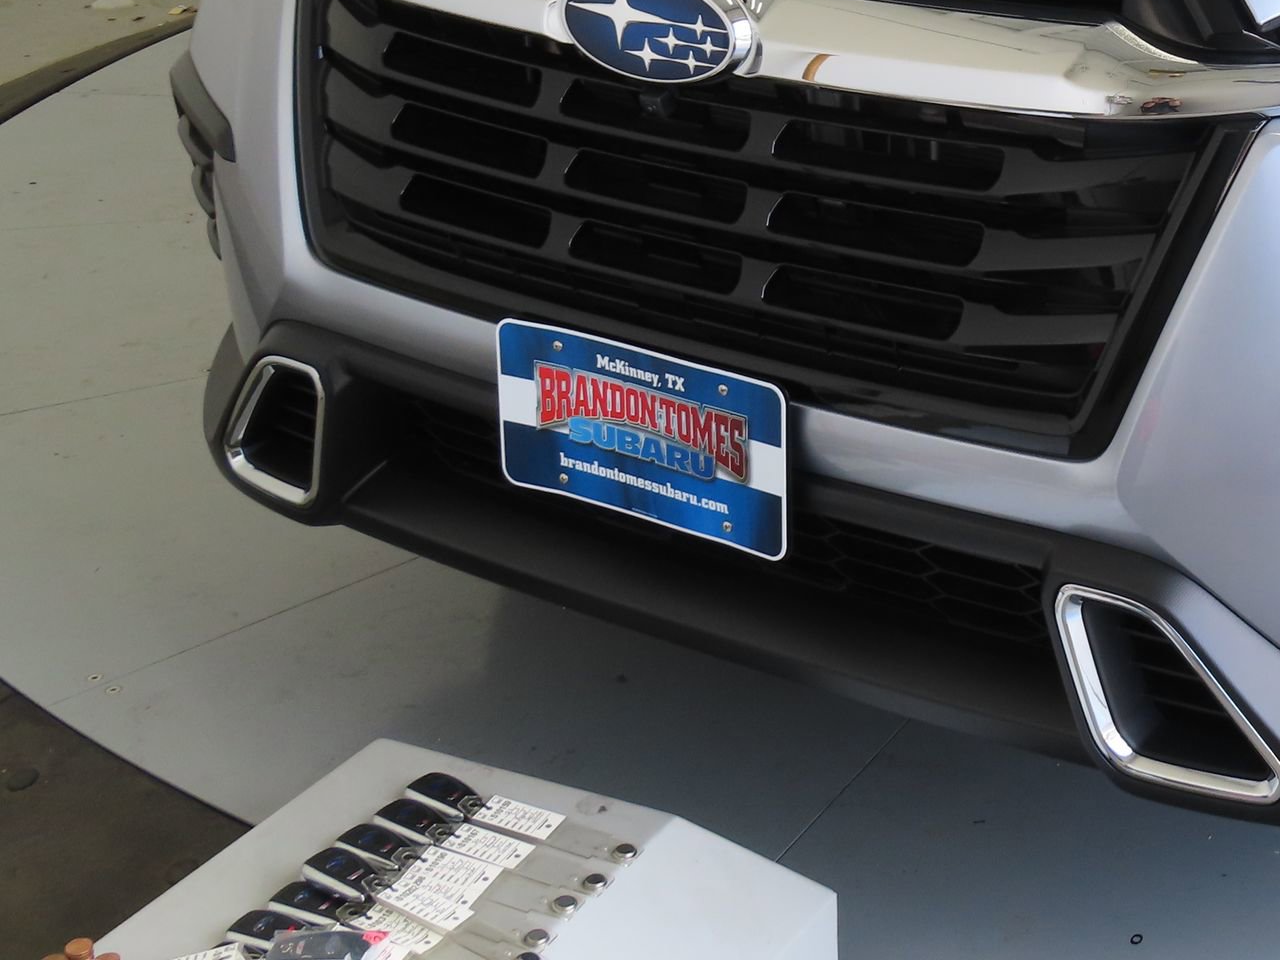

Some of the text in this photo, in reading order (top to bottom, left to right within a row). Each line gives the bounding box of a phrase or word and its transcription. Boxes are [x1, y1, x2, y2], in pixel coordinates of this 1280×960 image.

[596, 353, 686, 393] McKinney, TX
[567, 416, 715, 480] SUBARU
[559, 451, 729, 515] brandontomessubaru.com
